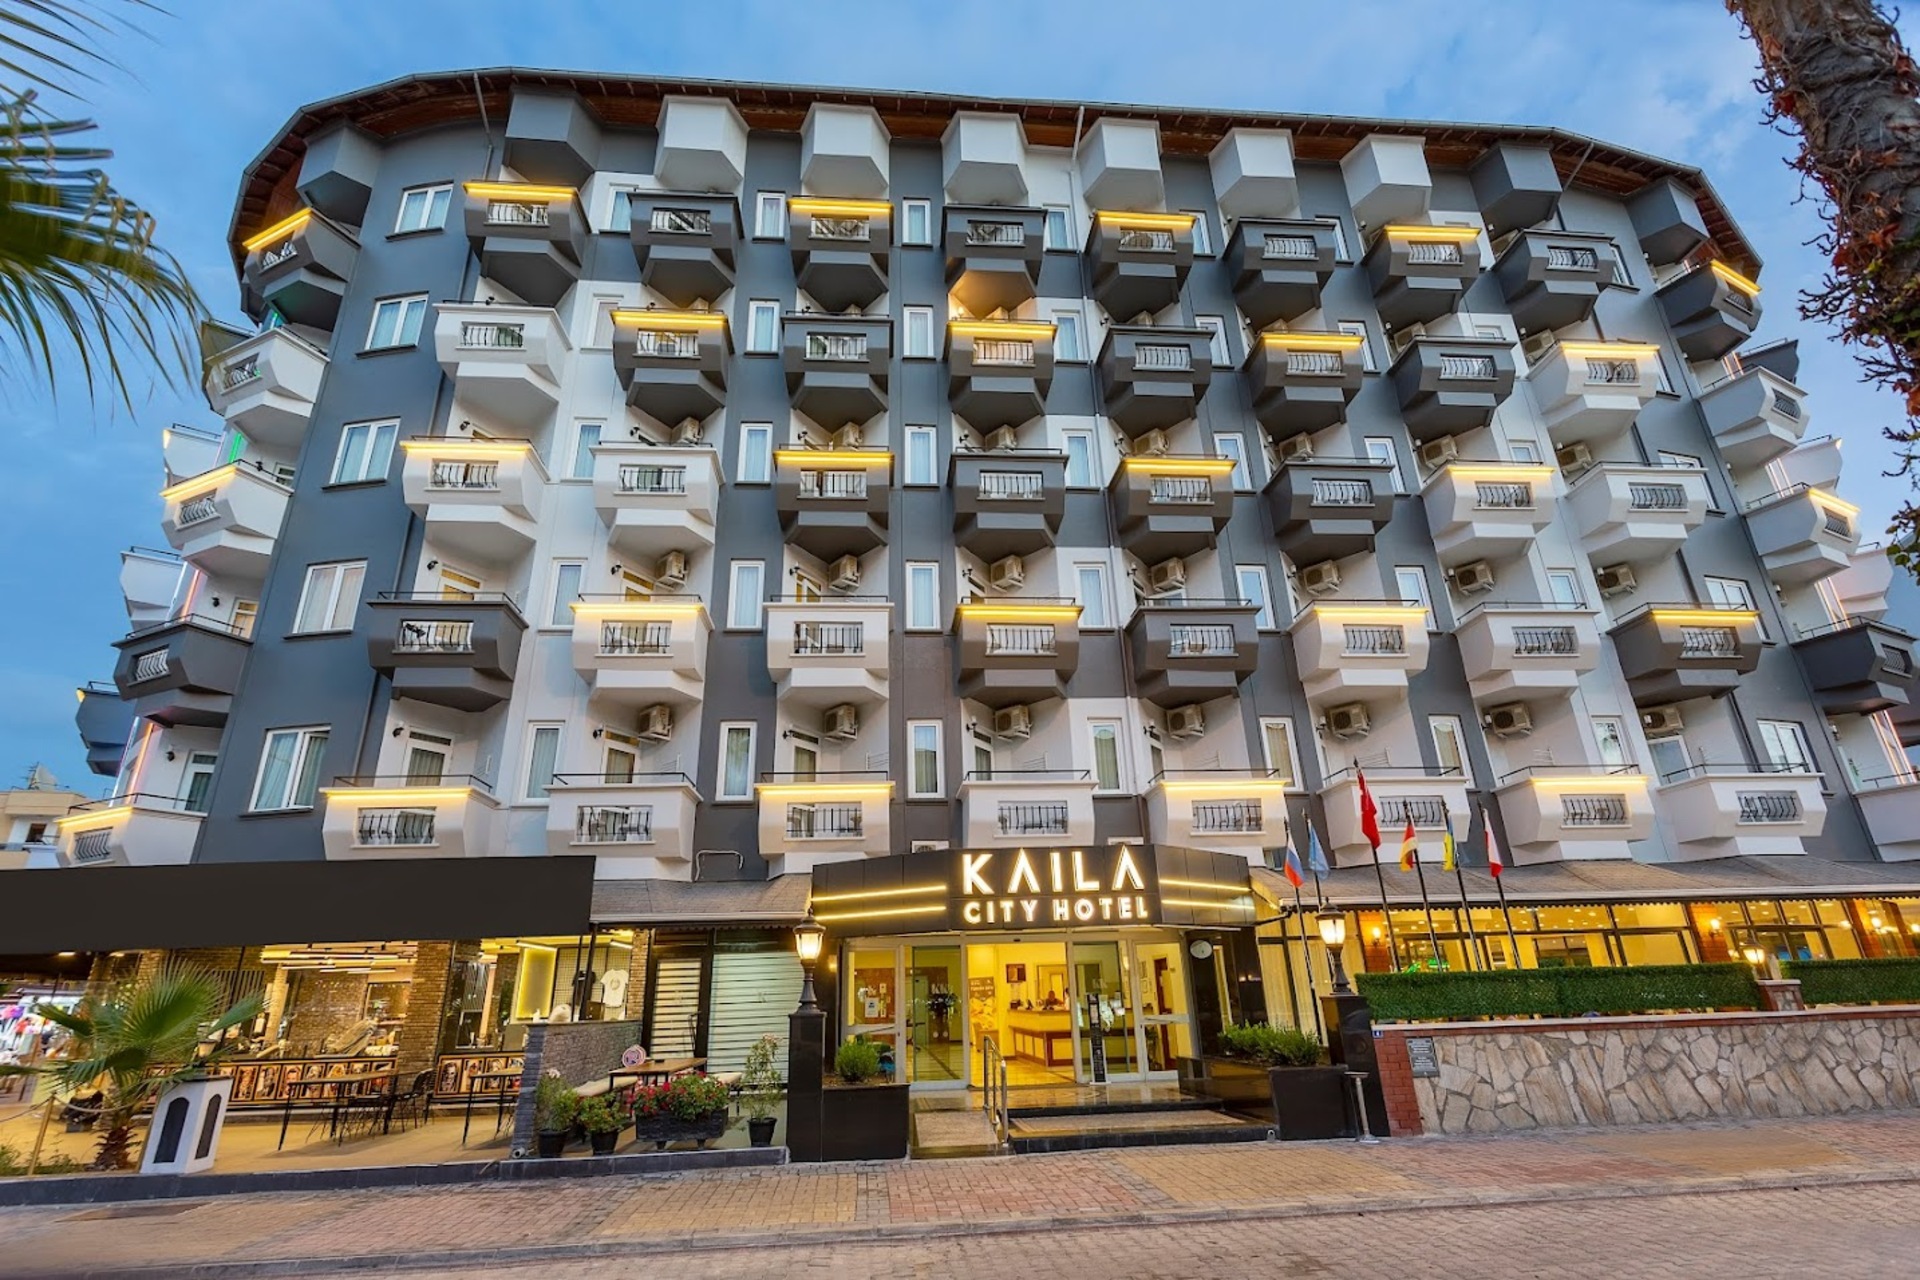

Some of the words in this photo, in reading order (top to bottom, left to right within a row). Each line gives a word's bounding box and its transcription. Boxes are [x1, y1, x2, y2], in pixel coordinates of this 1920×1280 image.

[962, 845, 1145, 895] KAILA
[963, 900, 1038, 924] CITY
[1052, 897, 1148, 921] HOTEL
